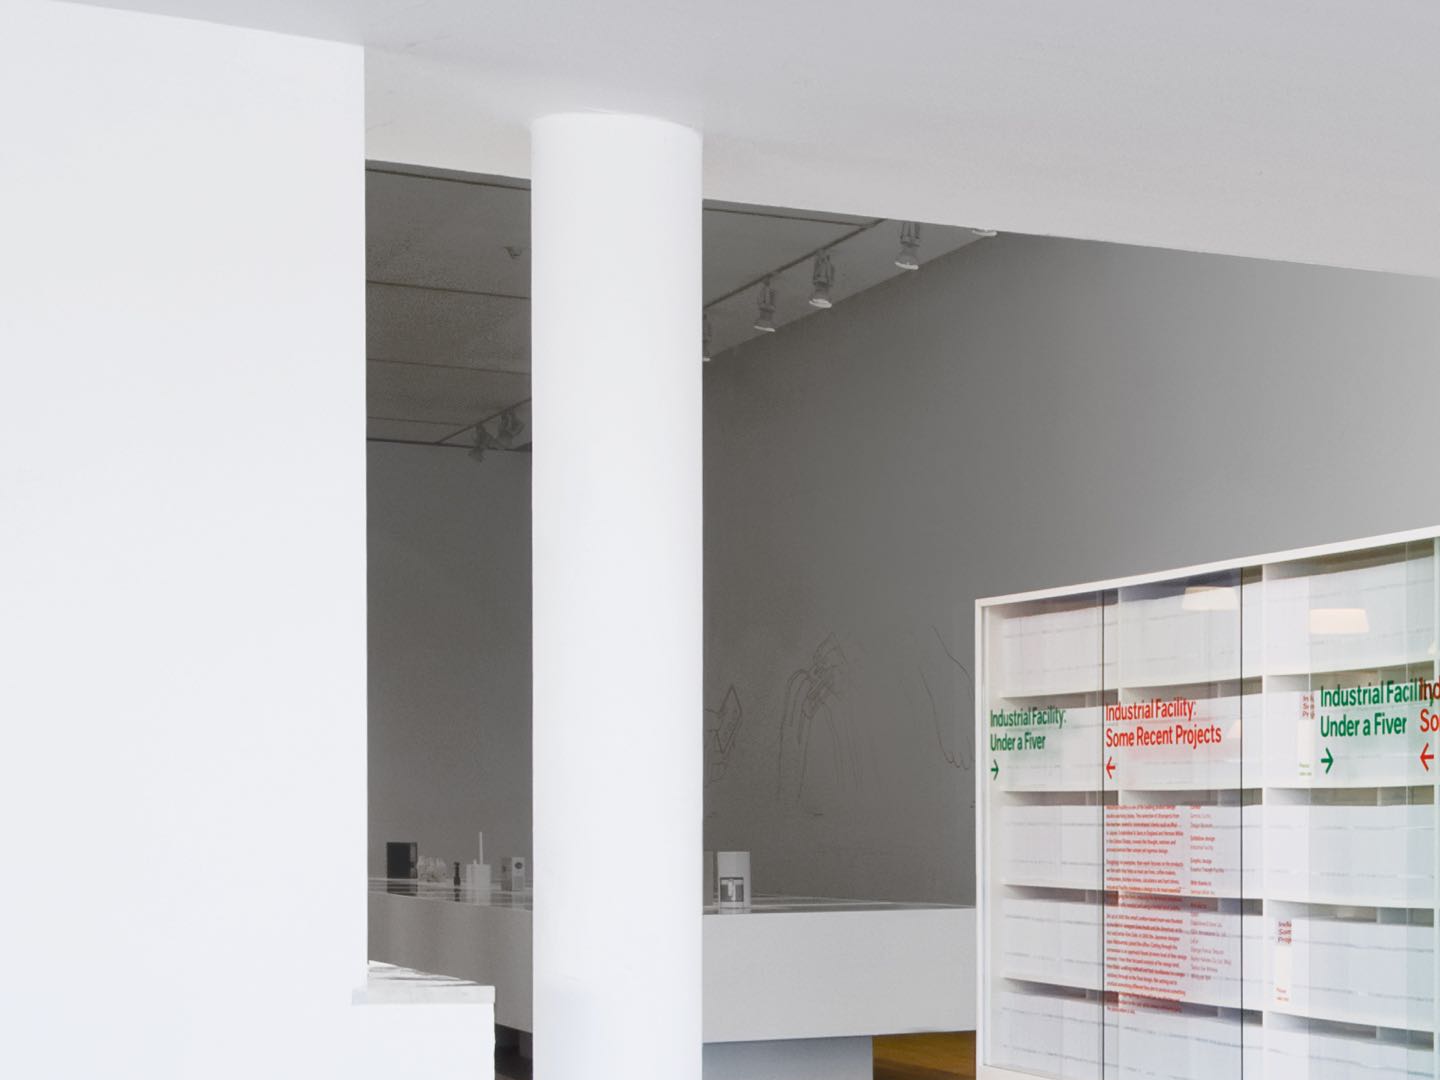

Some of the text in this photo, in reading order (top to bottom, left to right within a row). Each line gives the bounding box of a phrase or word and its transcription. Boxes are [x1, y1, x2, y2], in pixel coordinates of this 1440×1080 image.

[1321, 681, 1384, 707] Industrial
[990, 705, 1066, 728] Industrial Facility:
[1106, 697, 1197, 721] Industrial Facility:
[1106, 724, 1221, 749] Some Recent Projects
[1321, 712, 1407, 737] Under a Fiver
[990, 732, 1046, 751] Under a Fiver
